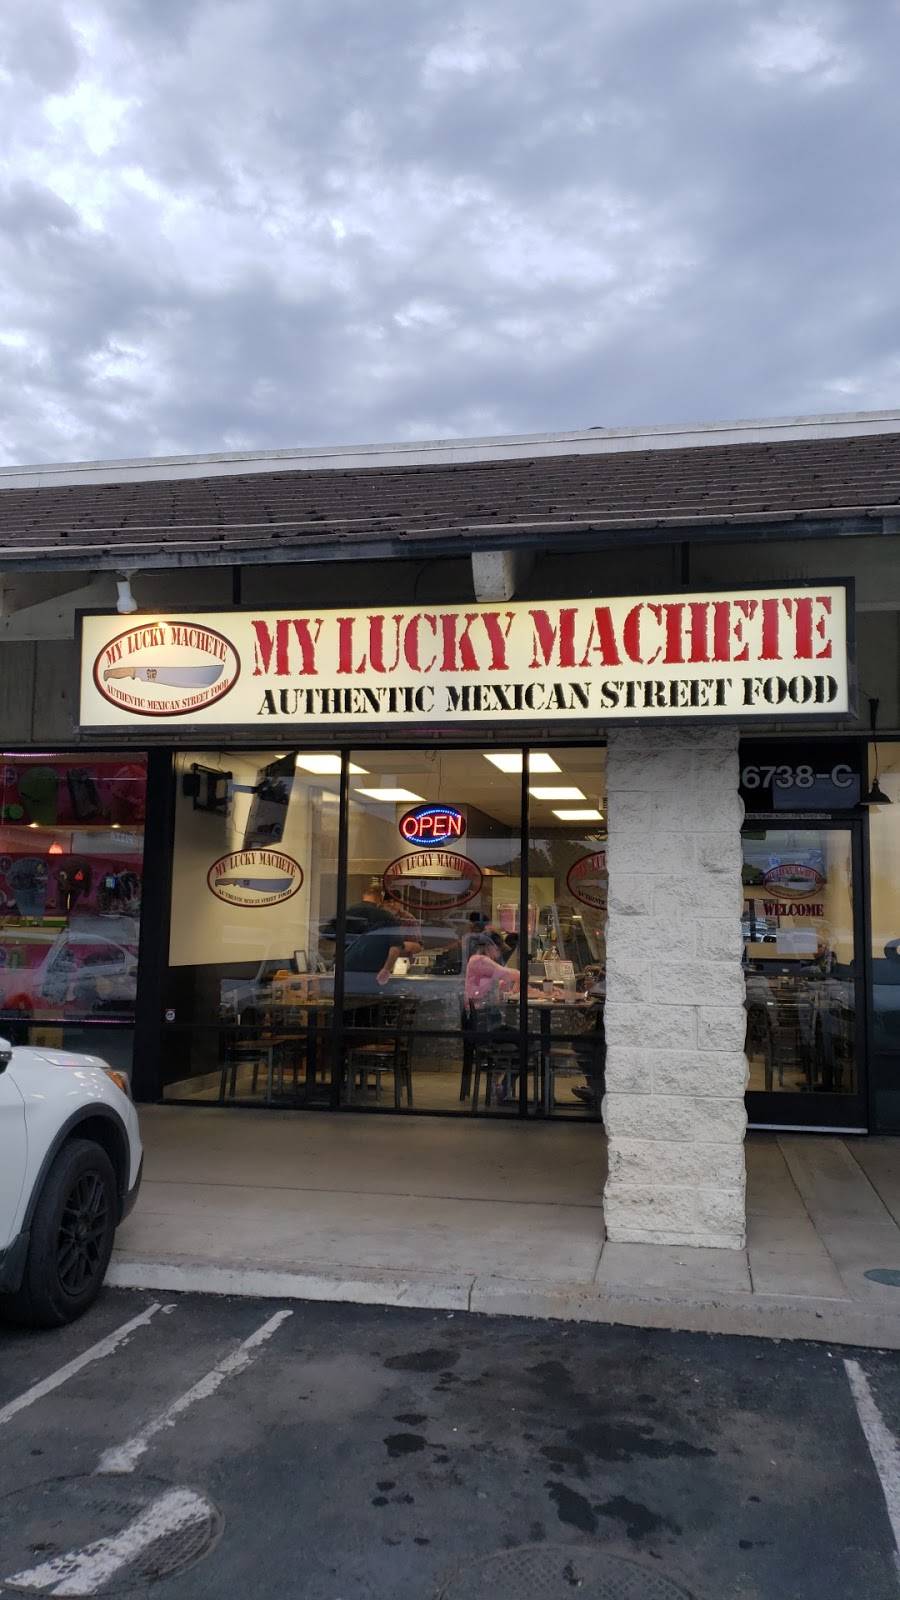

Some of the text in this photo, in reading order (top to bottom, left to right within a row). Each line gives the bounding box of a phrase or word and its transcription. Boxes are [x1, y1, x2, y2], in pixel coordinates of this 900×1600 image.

[105, 626, 228, 668] MY LUCKY MACHETE
[251, 596, 833, 676] MY LUCKY MACHETE
[106, 678, 230, 710] AUTHENTIC MEXICAN STREET FOOD
[257, 674, 839, 715] AUTHENTIC MEXICAN STREET FOOD
[742, 765, 852, 788] 6738-C
[402, 814, 462, 837] OPEN
[230, 852, 257, 870] LUCKY
[259, 852, 297, 878] MACHETE
[764, 903, 824, 916] WELCOME
